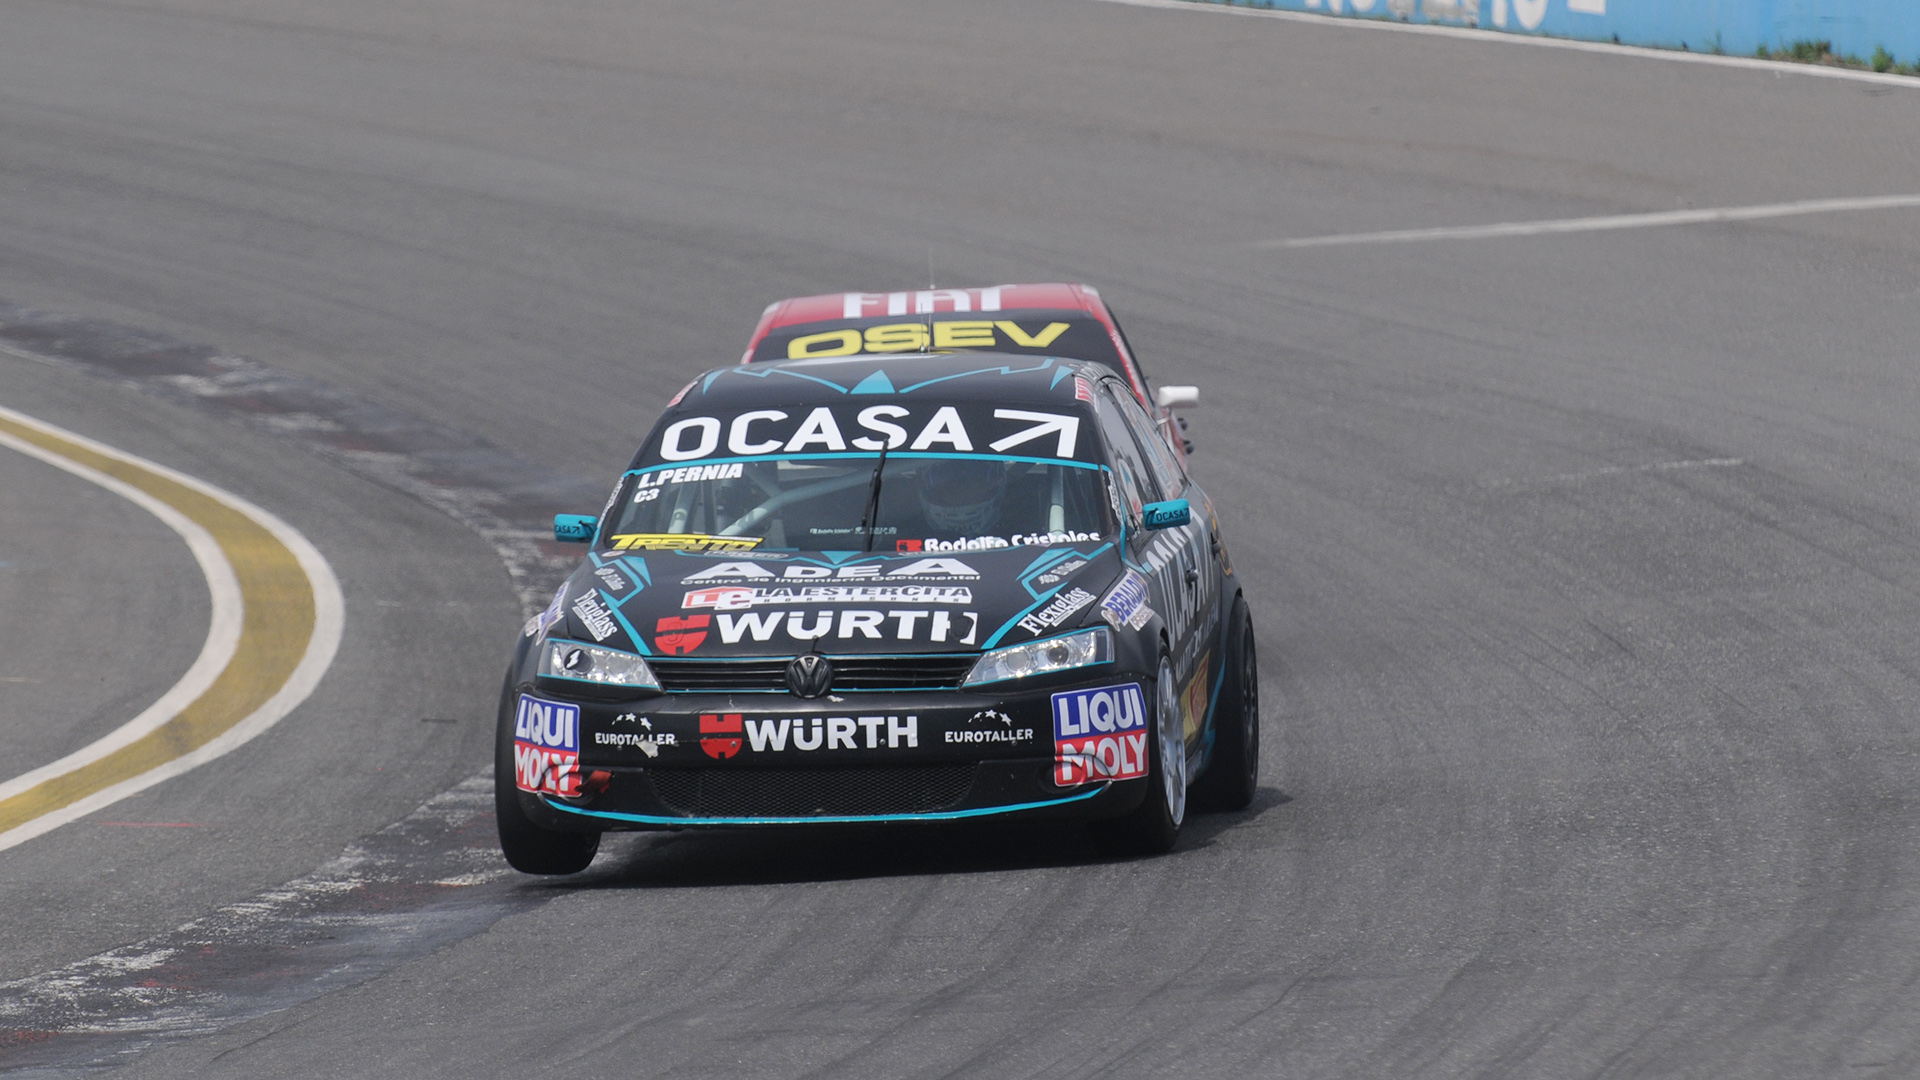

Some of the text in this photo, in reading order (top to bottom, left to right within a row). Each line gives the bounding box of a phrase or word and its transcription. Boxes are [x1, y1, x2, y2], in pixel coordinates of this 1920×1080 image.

[843, 284, 1017, 319] FIAT
[788, 320, 1071, 360] OSEV
[659, 405, 974, 461] OCASA
[638, 463, 744, 489] L.PERNIA
[633, 488, 660, 503] C3
[1155, 509, 1184, 522] OCASA
[611, 533, 763, 551] TRENTO
[680, 576, 743, 586] Centro
[747, 575, 771, 583] de
[871, 574, 981, 583] Documental
[684, 558, 980, 581] ADEA
[755, 585, 971, 597] LA ESTERCITA
[574, 588, 618, 638] Flexiglass
[1017, 587, 1092, 637] Flexiglass
[515, 699, 575, 746] LIQUI
[1058, 688, 1144, 736] LIQUI
[745, 716, 918, 751] WÜRTH
[945, 728, 1034, 743] EUROTALLER
[514, 744, 577, 792] MOLY
[1061, 733, 1147, 781] MOLY
